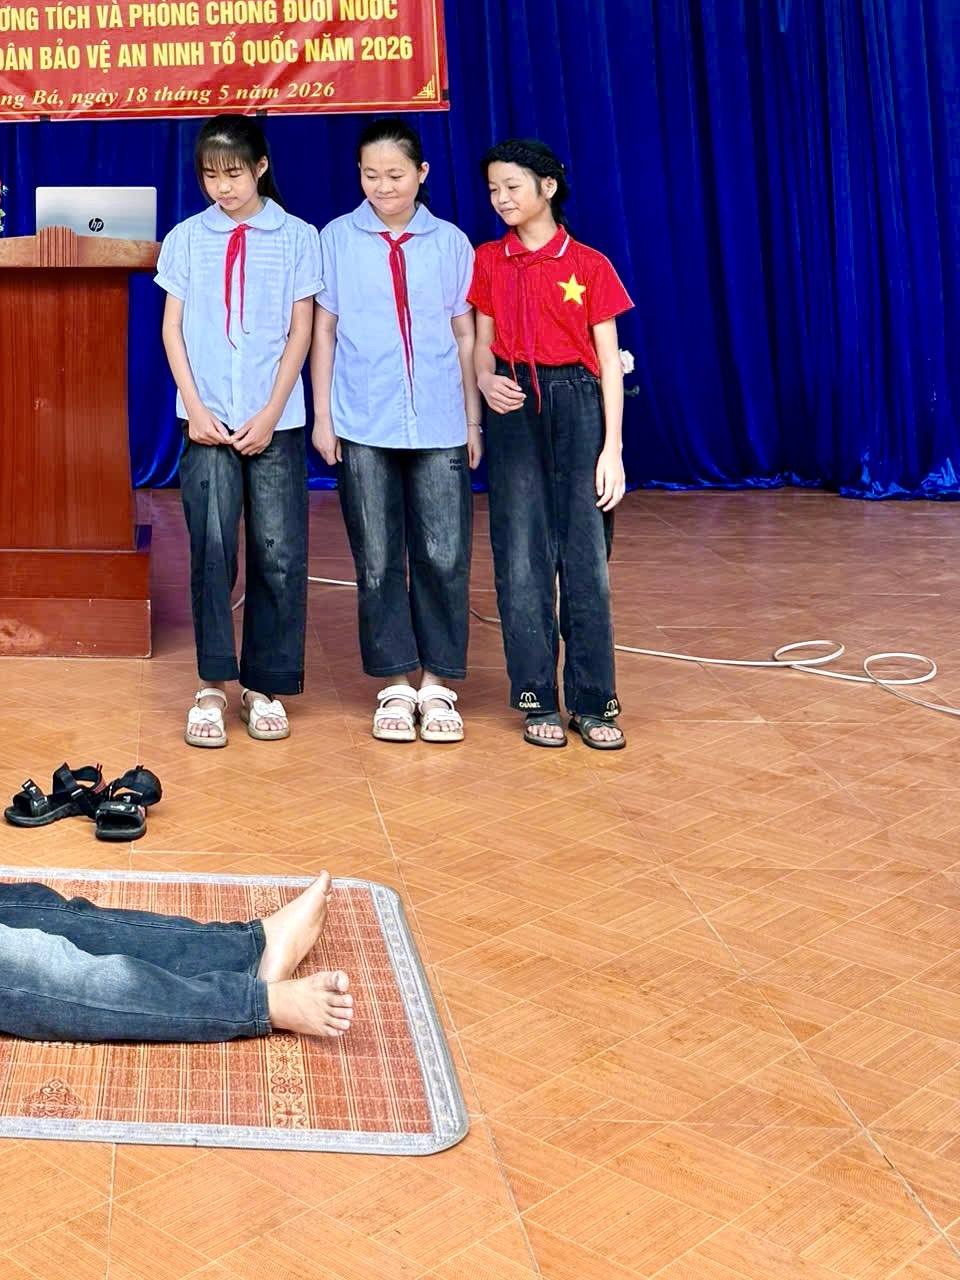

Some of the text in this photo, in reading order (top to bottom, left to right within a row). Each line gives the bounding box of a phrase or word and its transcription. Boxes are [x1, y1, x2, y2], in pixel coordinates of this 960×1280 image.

[45, 2, 90, 30] TÍCH
[96, 0, 123, 29] VÀ
[40, 38, 80, 70] BẢO
[86, 40, 111, 73] VỆ
[117, 44, 147, 68] AN
[153, 41, 204, 66] NINH
[210, 32, 236, 65] TỔ
[242, 31, 298, 66] QUỐC
[304, 33, 354, 62] NĂM
[361, 35, 413, 60] 2026
[32, 89, 64, 107] Bá,
[70, 86, 118, 107] ngày
[125, 87, 147, 102] 18
[153, 85, 212, 103] tháng
[218, 86, 229, 100] 5
[235, 83, 280, 100] năm
[286, 81, 336, 98] 2026
[89, 217, 104, 232] hp
